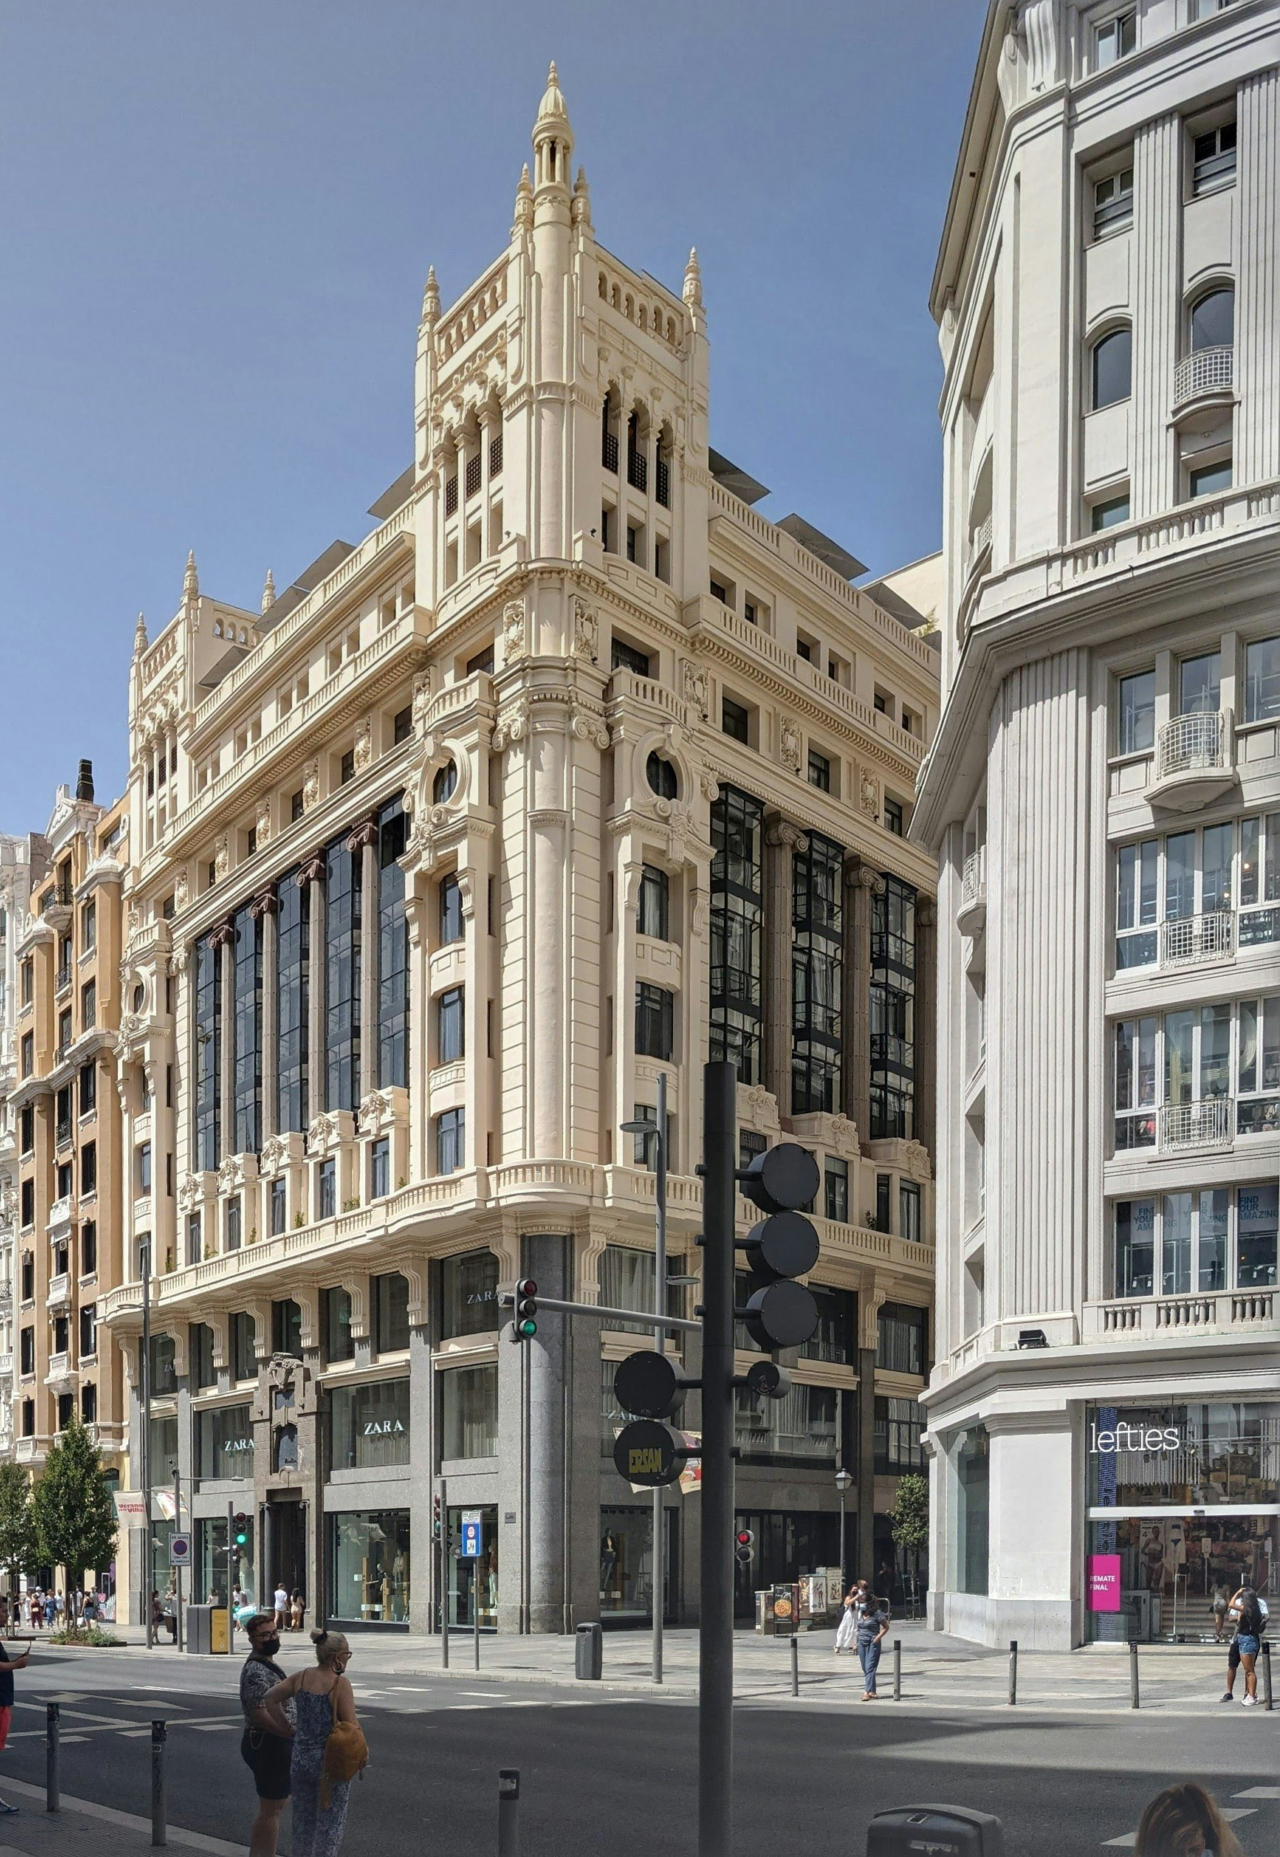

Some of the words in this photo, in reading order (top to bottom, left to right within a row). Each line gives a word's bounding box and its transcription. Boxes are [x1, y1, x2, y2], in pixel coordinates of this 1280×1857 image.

[363, 1418, 405, 1436] ZARA
[224, 1437, 256, 1452] ZARA
[1089, 1421, 1180, 1453] lefties
[1089, 1583, 1109, 1591] FINAL
